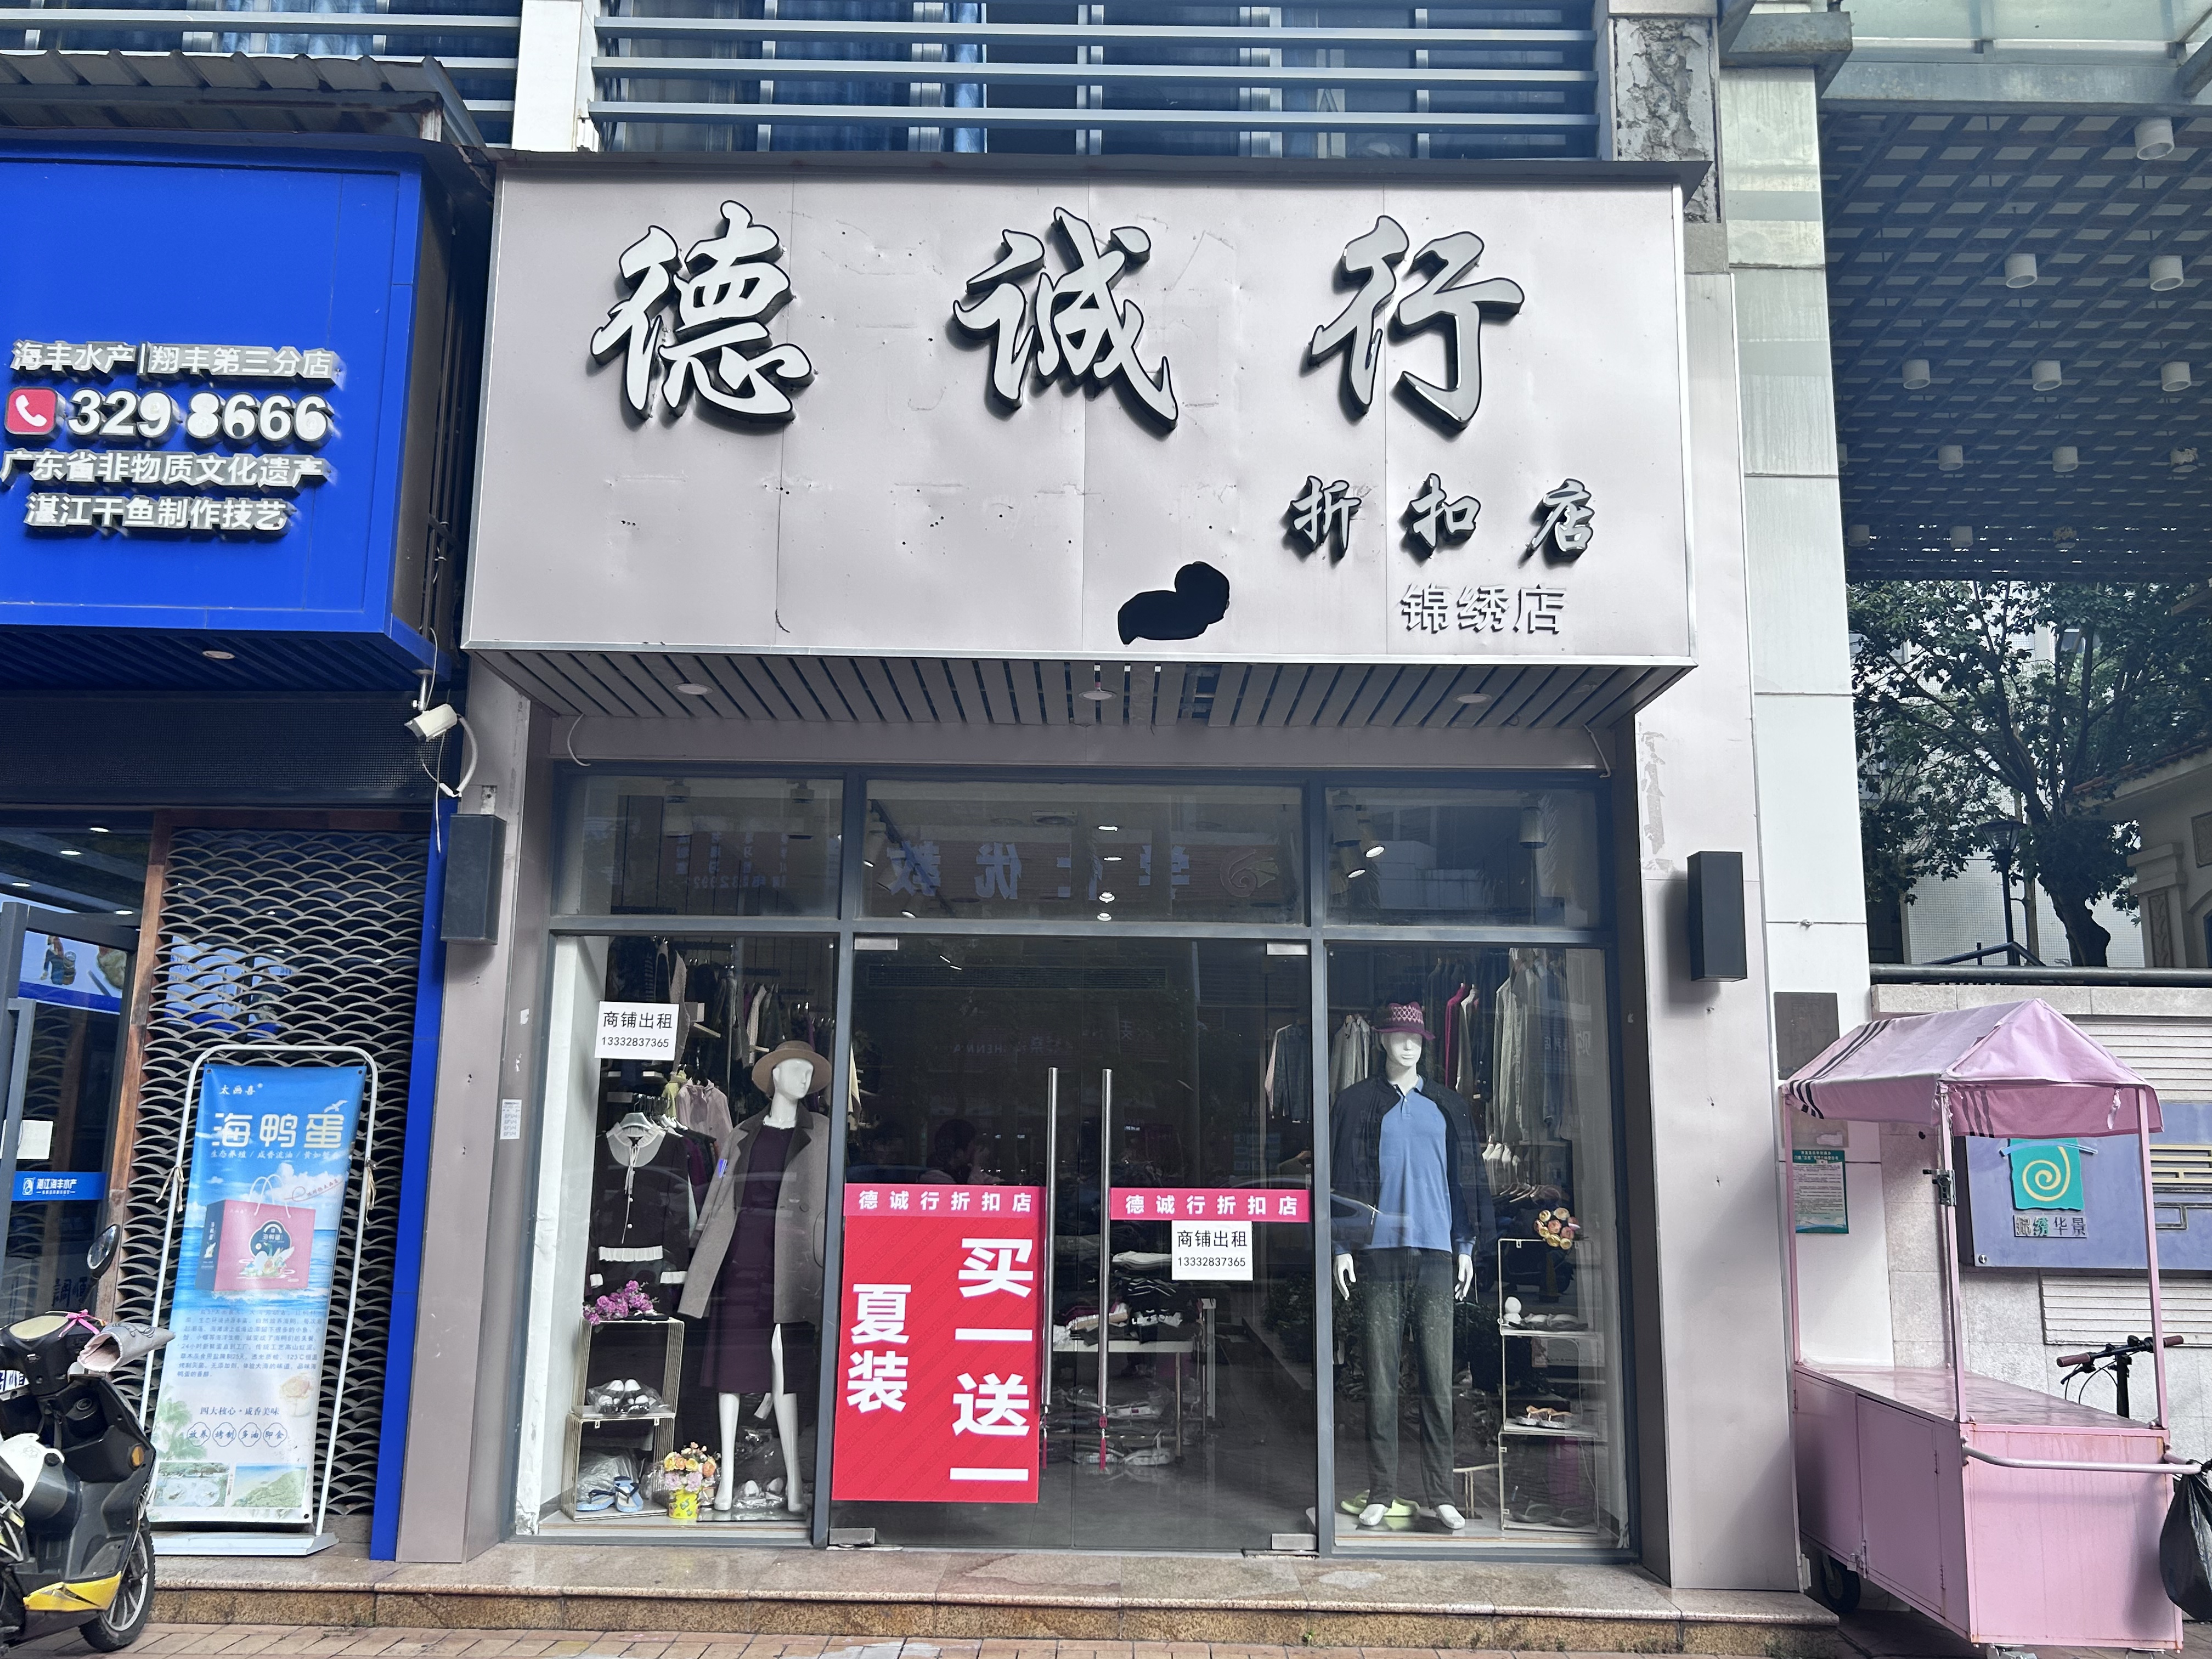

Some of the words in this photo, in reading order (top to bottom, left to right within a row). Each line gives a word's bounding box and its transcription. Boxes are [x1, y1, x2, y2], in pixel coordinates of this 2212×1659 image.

[591, 200, 1524, 431] 德诚行
[67, 388, 173, 438] 329
[186, 392, 330, 442] 8666
[1, 451, 324, 488] 广东省非物质文化遗产
[26, 494, 289, 531] 湛江干鱼制作技艺
[1288, 473, 1595, 558] 折扣店
[1401, 583, 1567, 634] 锦绣店
[603, 1011, 673, 1029] 商铺出租
[602, 1036, 669, 1048] 13332837365
[212, 1113, 345, 1148] 海鸭蛋
[859, 1190, 1032, 1213] 德诚行折扣店
[1125, 1195, 1297, 1216] 德诚行折扣店
[1177, 1229, 1248, 1248] 商铺出租
[1178, 1257, 1246, 1267] 13332837365
[847, 1284, 911, 1413] 夏装
[950, 1238, 1034, 1481] 买一送一
